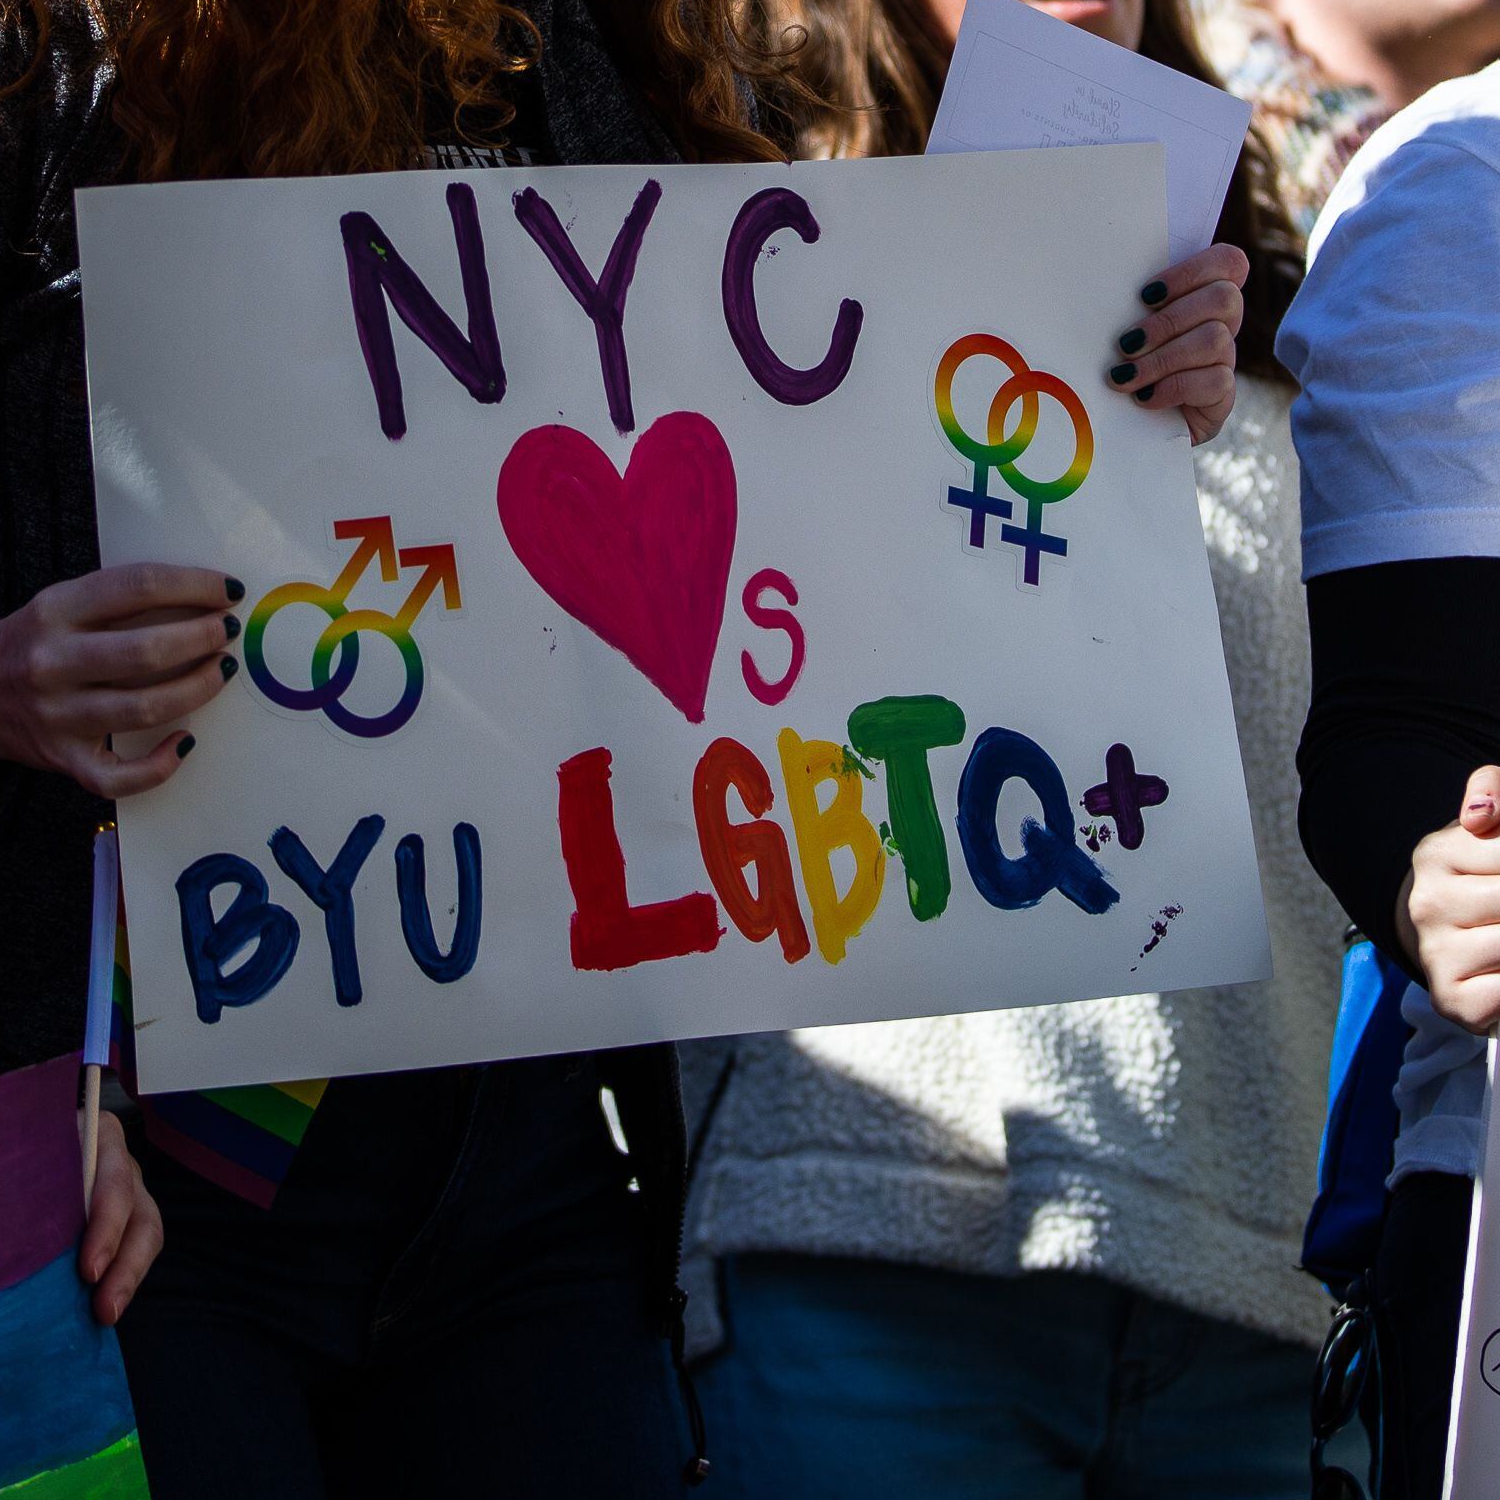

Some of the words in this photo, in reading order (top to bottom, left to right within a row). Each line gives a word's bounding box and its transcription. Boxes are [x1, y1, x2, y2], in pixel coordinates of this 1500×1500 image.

[340, 179, 864, 441] NYC
[175, 814, 482, 1025] BYU
[556, 694, 1171, 974] LGBTQ+
